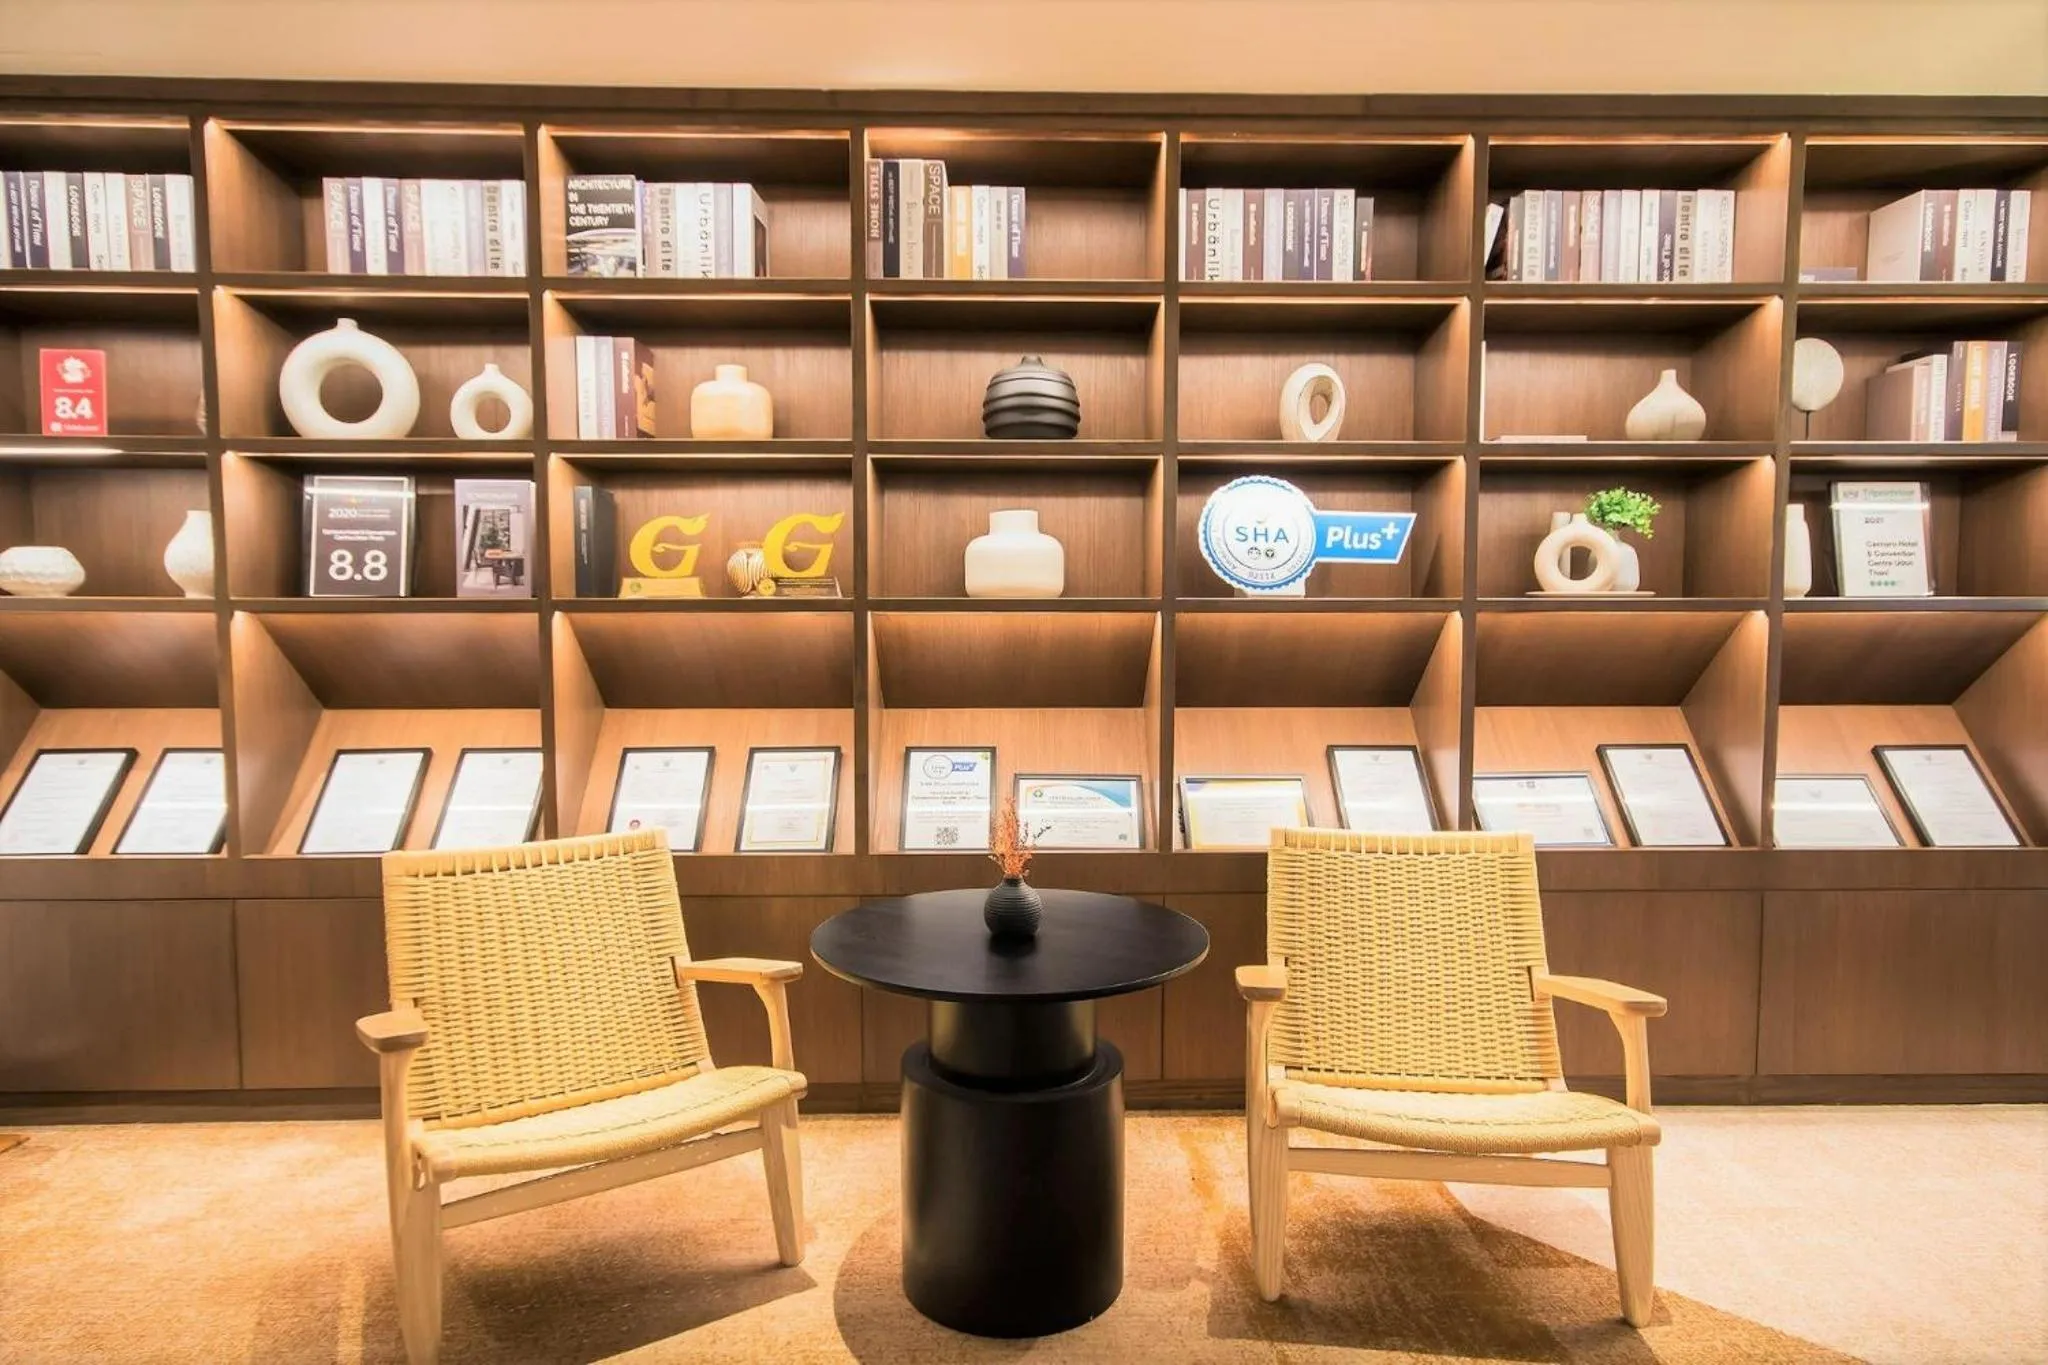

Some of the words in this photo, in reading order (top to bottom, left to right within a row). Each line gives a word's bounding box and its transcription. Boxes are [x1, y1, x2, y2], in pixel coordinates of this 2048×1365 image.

[568, 179, 632, 190] ARCHITECTURE
[928, 165, 941, 215] SPACE
[131, 180, 147, 229] SPACE
[329, 183, 345, 230] SPACE
[405, 184, 420, 232] SPACE
[568, 203, 586, 214] THE
[587, 203, 634, 215] TWENTIETH
[659, 187, 671, 235] Dentro
[569, 216, 610, 227] CENTURY
[1585, 195, 1599, 241] SPACE
[1679, 195, 1692, 241] Dentro
[661, 240, 672, 254] di
[1678, 246, 1690, 260] di
[661, 258, 672, 271] te
[1678, 264, 1690, 277] te
[2007, 353, 2016, 401] LOOKBOOK
[55, 397, 94, 419] 8.4
[328, 508, 357, 518] 2020
[1235, 526, 1289, 544] SHA
[328, 549, 388, 581] 8.8
